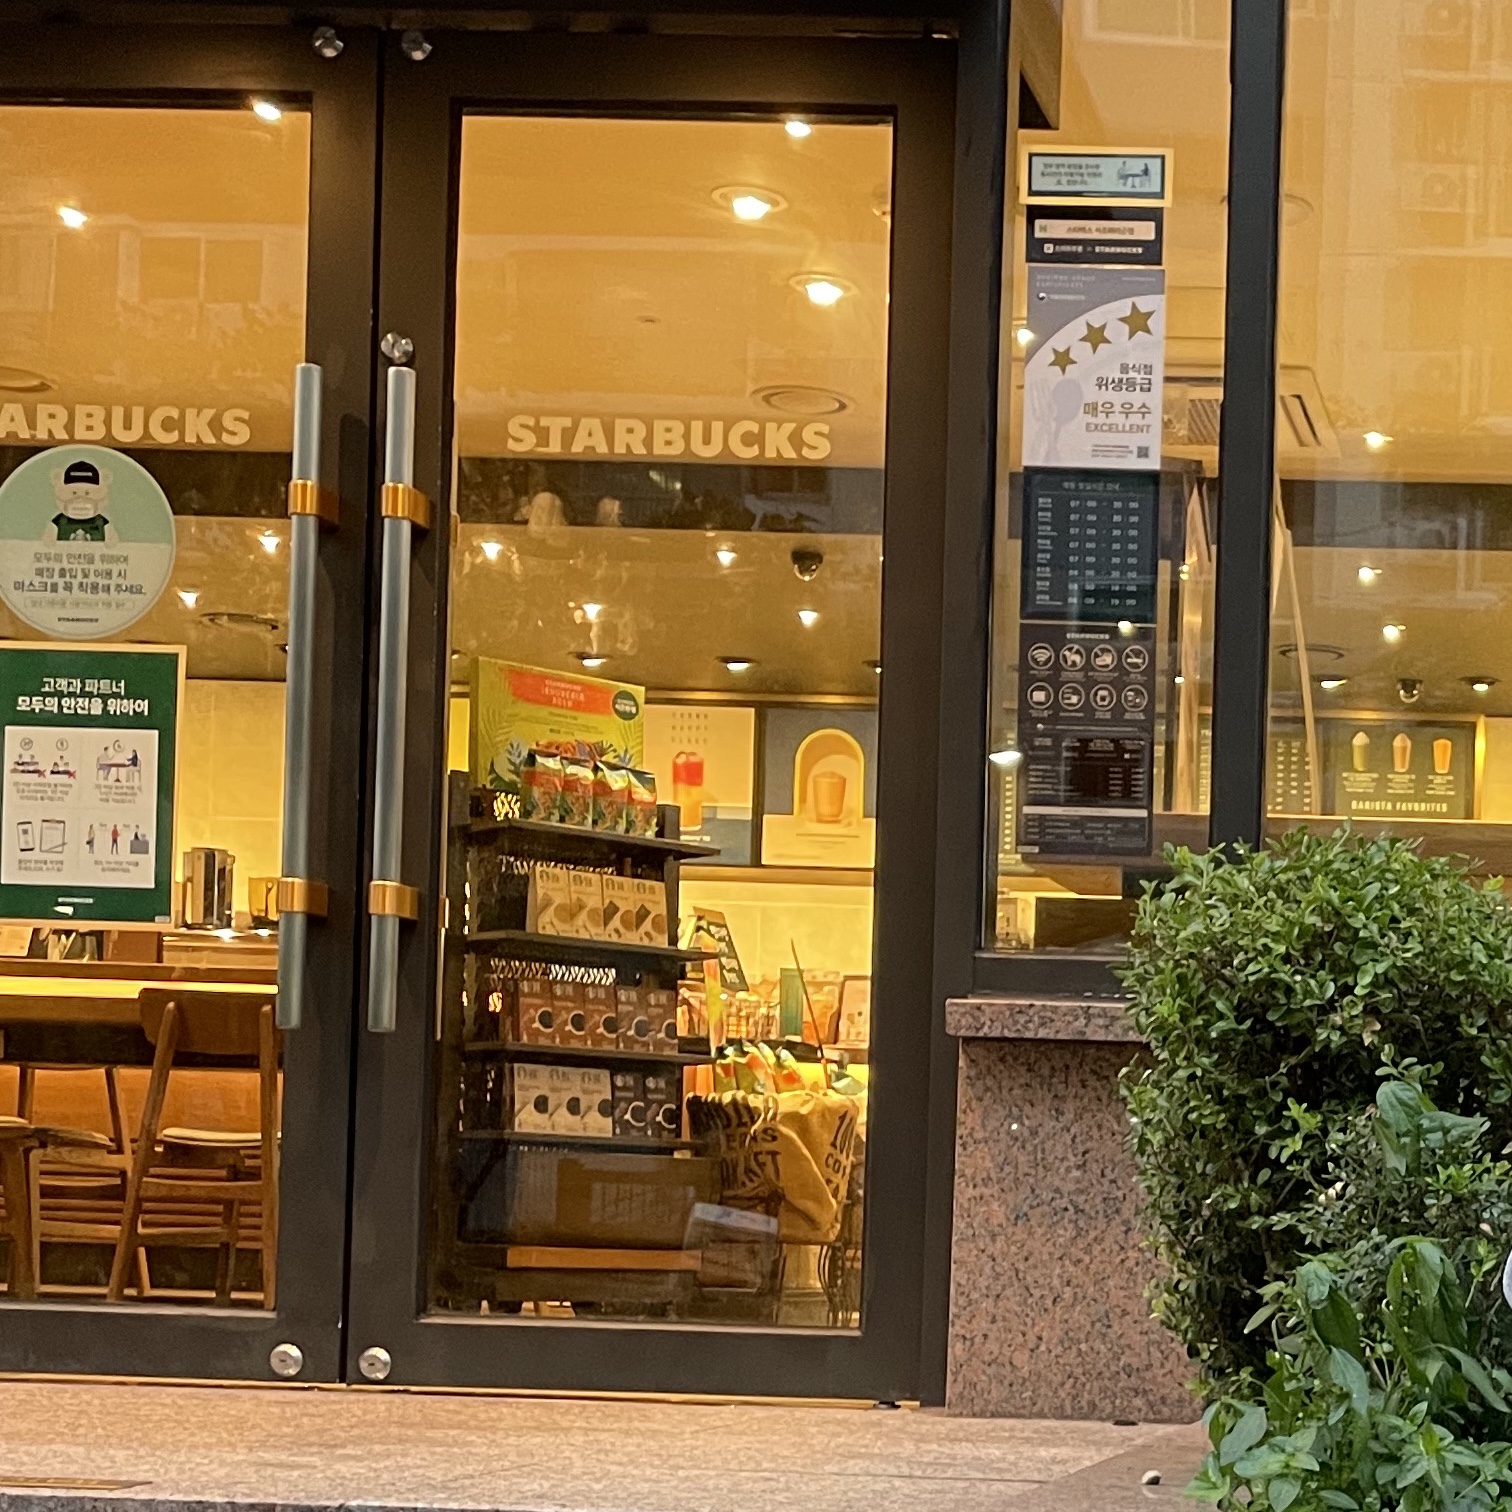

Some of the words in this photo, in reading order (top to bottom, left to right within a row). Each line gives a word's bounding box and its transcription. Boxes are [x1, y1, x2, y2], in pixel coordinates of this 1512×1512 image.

[1095, 376, 1152, 392] 위생등급
[1083, 401, 1116, 419] 매우
[1118, 402, 1152, 420] 우수
[1085, 422, 1152, 434] EXCELLENT
[507, 415, 831, 459] STARBUCKS
[117, 568, 127, 581] 시
[41, 677, 82, 694] 고객과
[84, 678, 125, 696] 파트너
[16, 696, 58, 713] 모두의
[61, 697, 103, 715] 안전을
[107, 698, 149, 716] 위하여
[1396, 801, 1448, 812] FAVORITES
